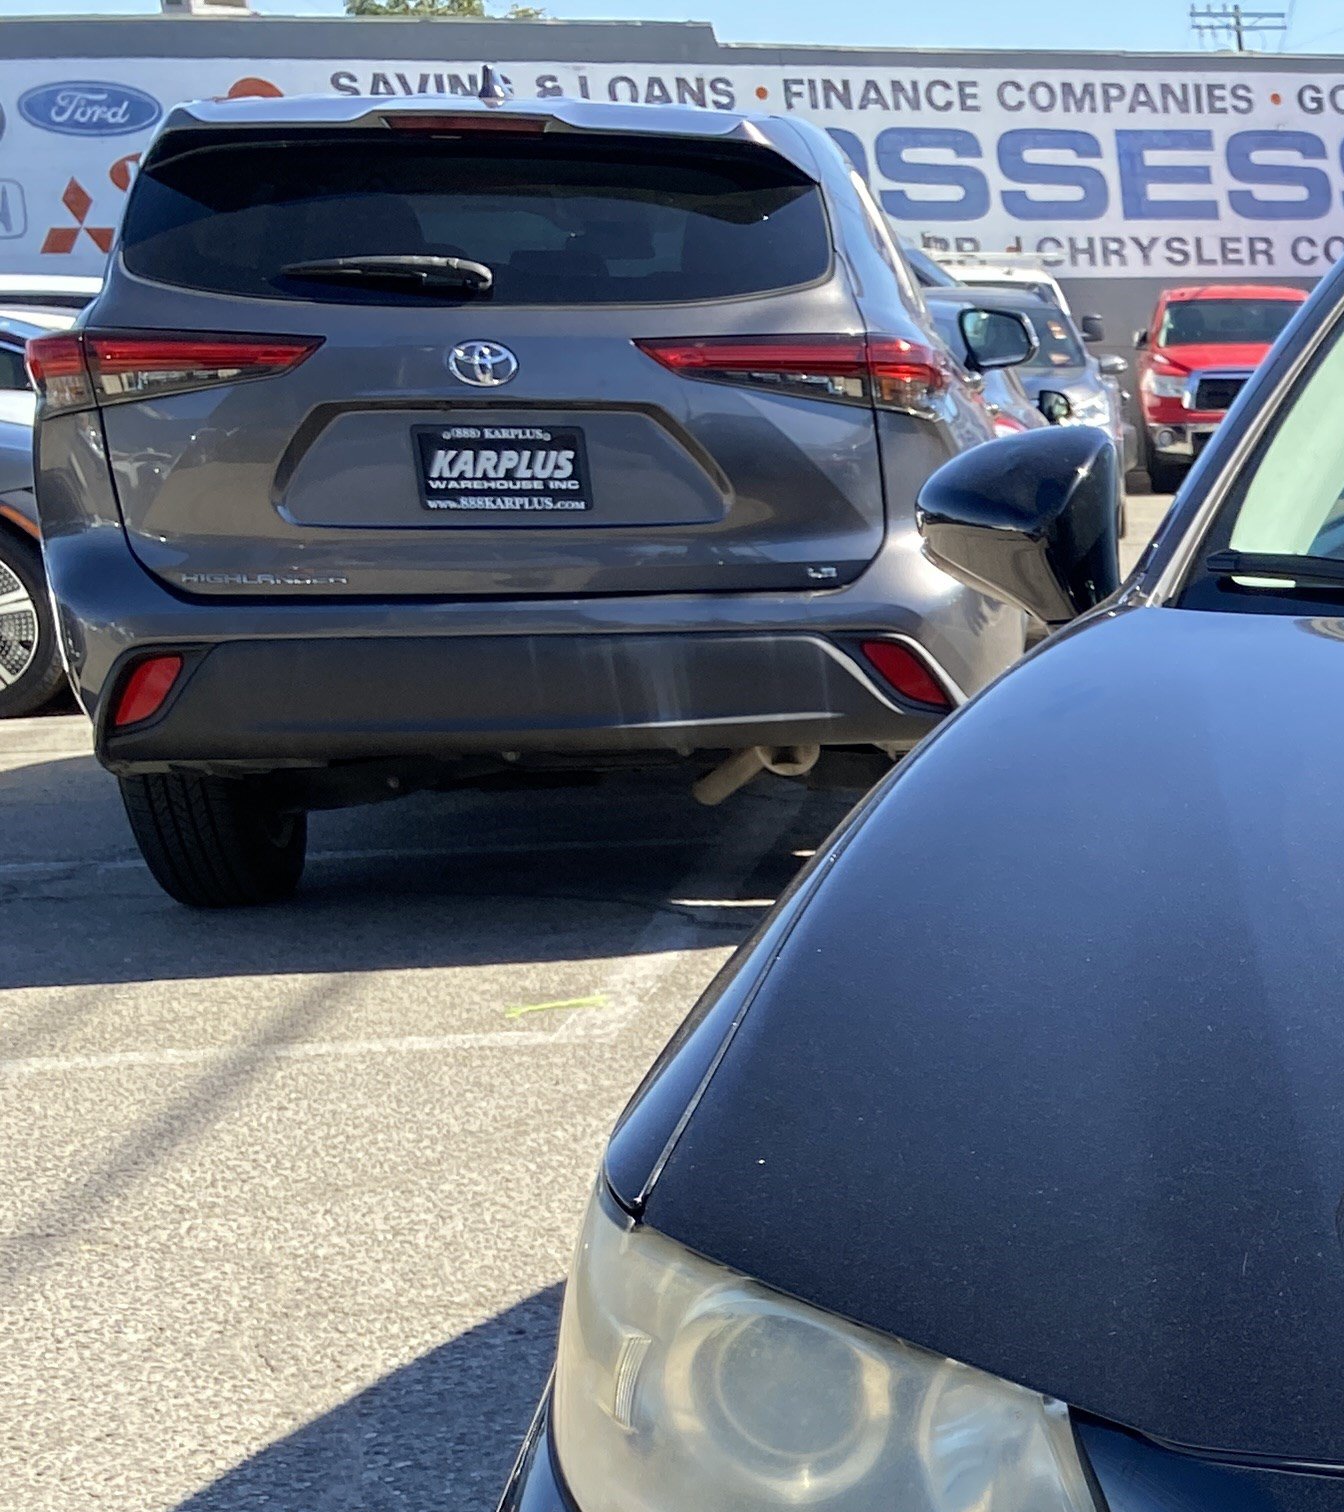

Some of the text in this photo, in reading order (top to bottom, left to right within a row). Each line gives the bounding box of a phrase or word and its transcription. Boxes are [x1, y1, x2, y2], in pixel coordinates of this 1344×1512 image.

[51, 91, 130, 124] Ford
[782, 77, 982, 113] FINANCE
[996, 80, 1255, 114] COMPANIES
[1036, 235, 1275, 267] CHRYSLER
[451, 428, 544, 439] (888) KARPLUS
[429, 449, 575, 479] KARPLUS
[428, 480, 580, 490] WAREHOUSE INC
